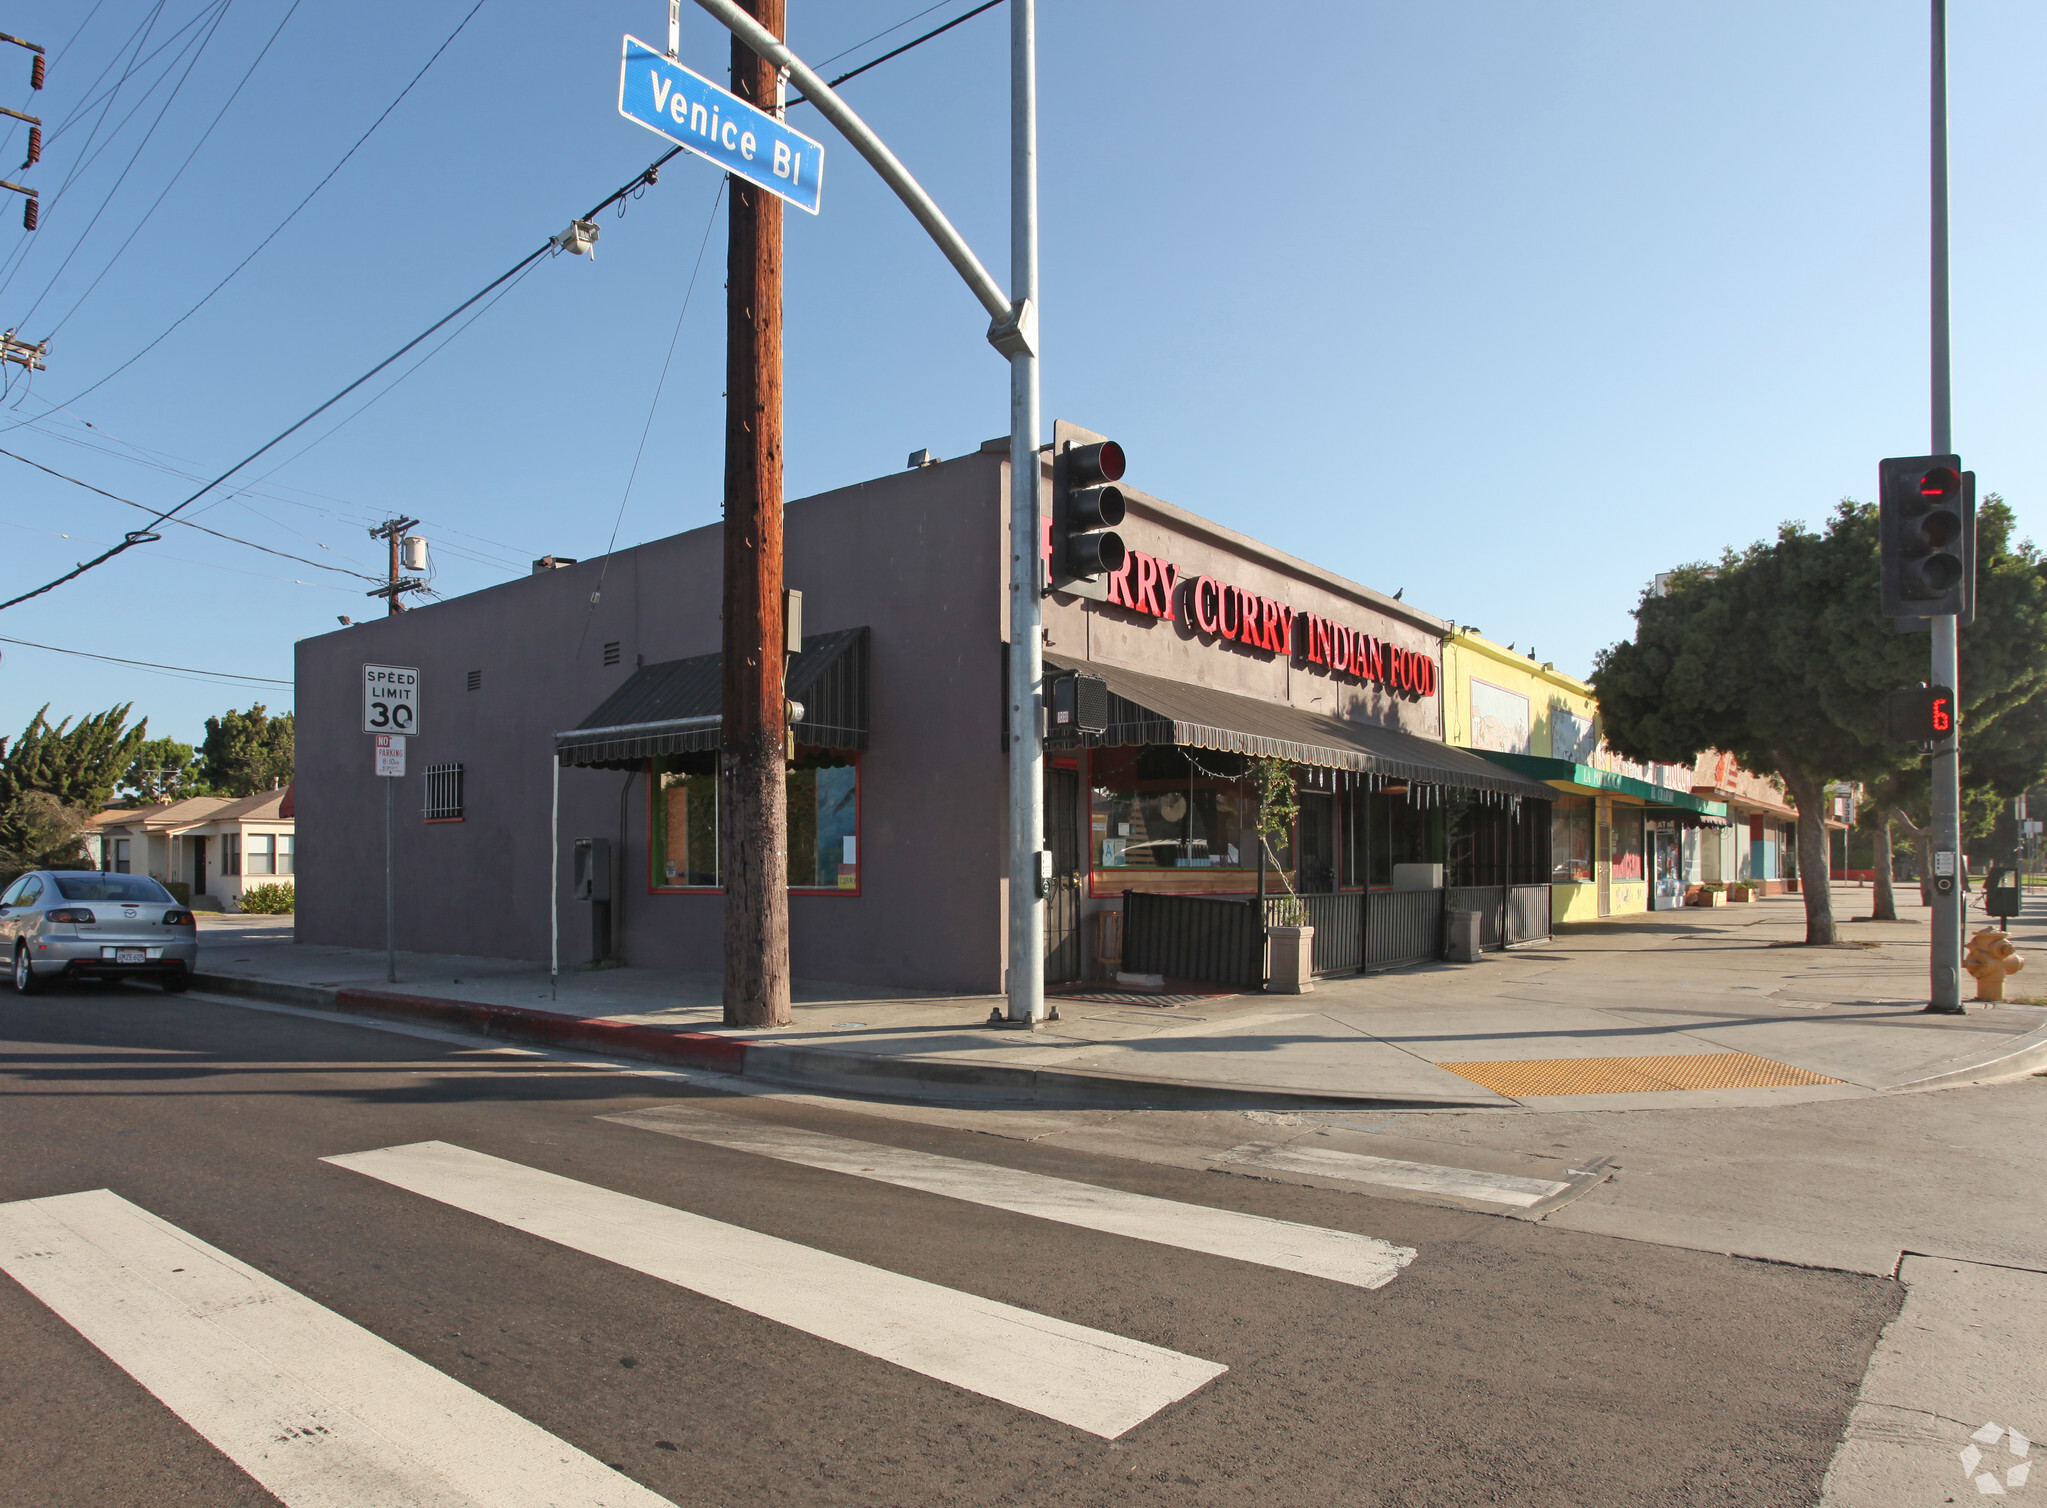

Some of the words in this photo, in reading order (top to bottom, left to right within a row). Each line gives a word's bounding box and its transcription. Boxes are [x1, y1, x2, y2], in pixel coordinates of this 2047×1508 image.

[650, 69, 757, 161] Venice
[772, 139, 801, 186] Bl
[1195, 574, 1295, 656] CURRY
[1305, 611, 1384, 684] INDIAN
[1390, 642, 1437, 697] FOOD
[367, 671, 415, 685] SPEED
[372, 687, 411, 700] LIMIT
[369, 702, 413, 729] 30
[1932, 698, 1950, 731] 6
[378, 736, 389, 747] NO
[378, 748, 404, 758] PARKING
[1105, 843, 1113, 857] A
